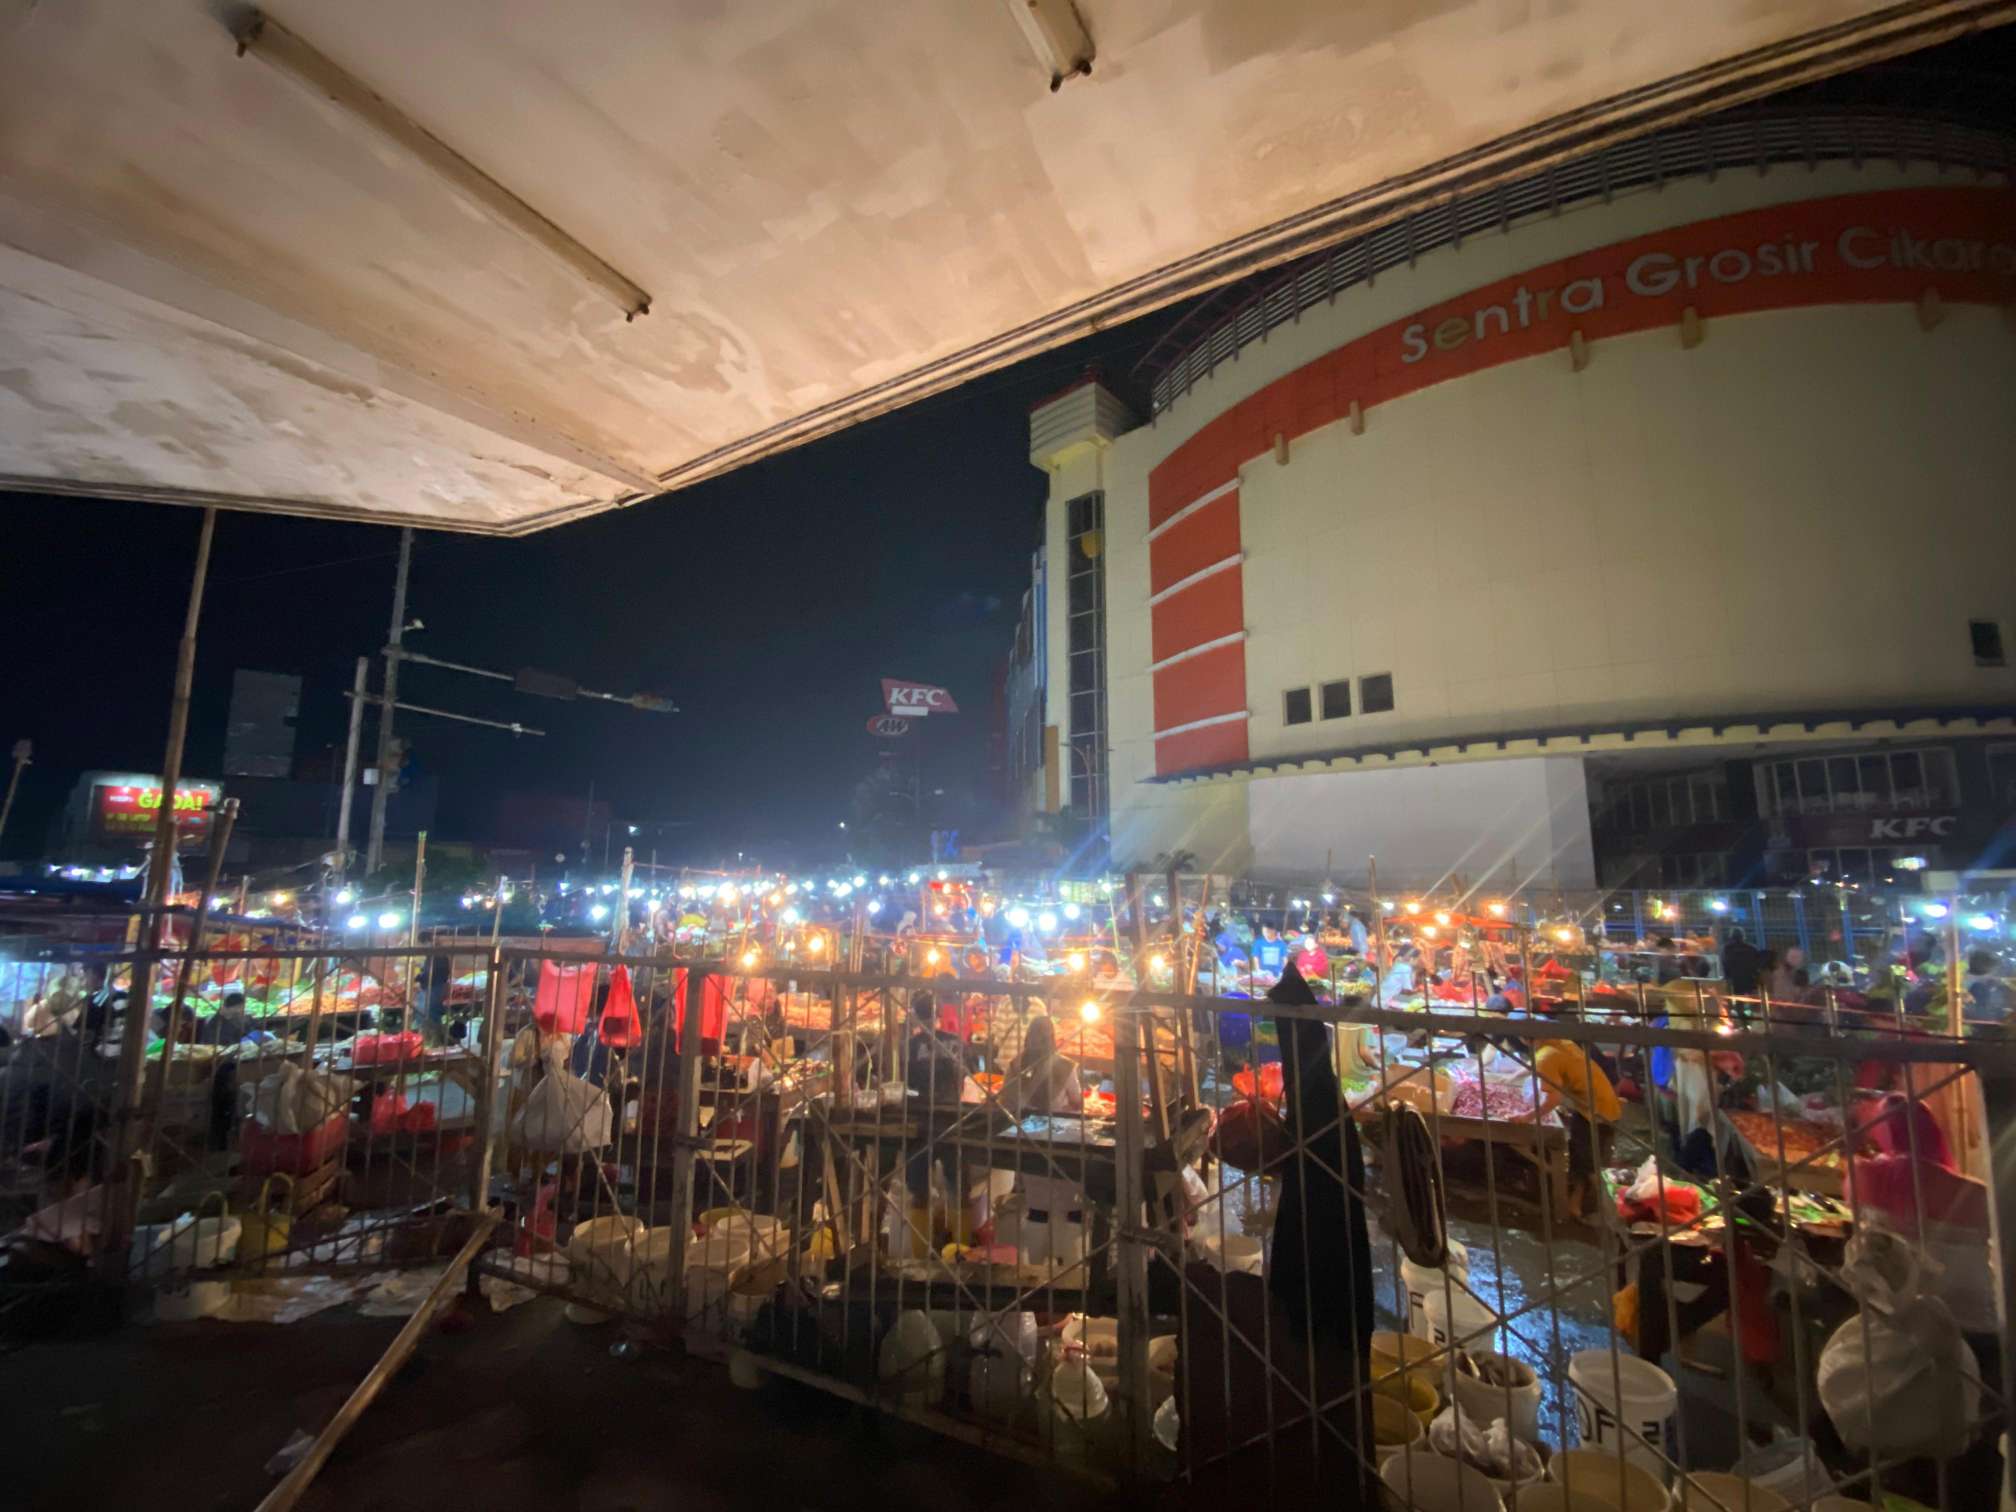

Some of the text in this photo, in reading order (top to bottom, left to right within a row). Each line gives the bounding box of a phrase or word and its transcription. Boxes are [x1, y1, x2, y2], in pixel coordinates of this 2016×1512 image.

[1401, 276, 1605, 364] Sentra
[1625, 233, 1820, 296] Grosir
[888, 687, 944, 706] KFC
[1869, 816, 1957, 839] KFC
